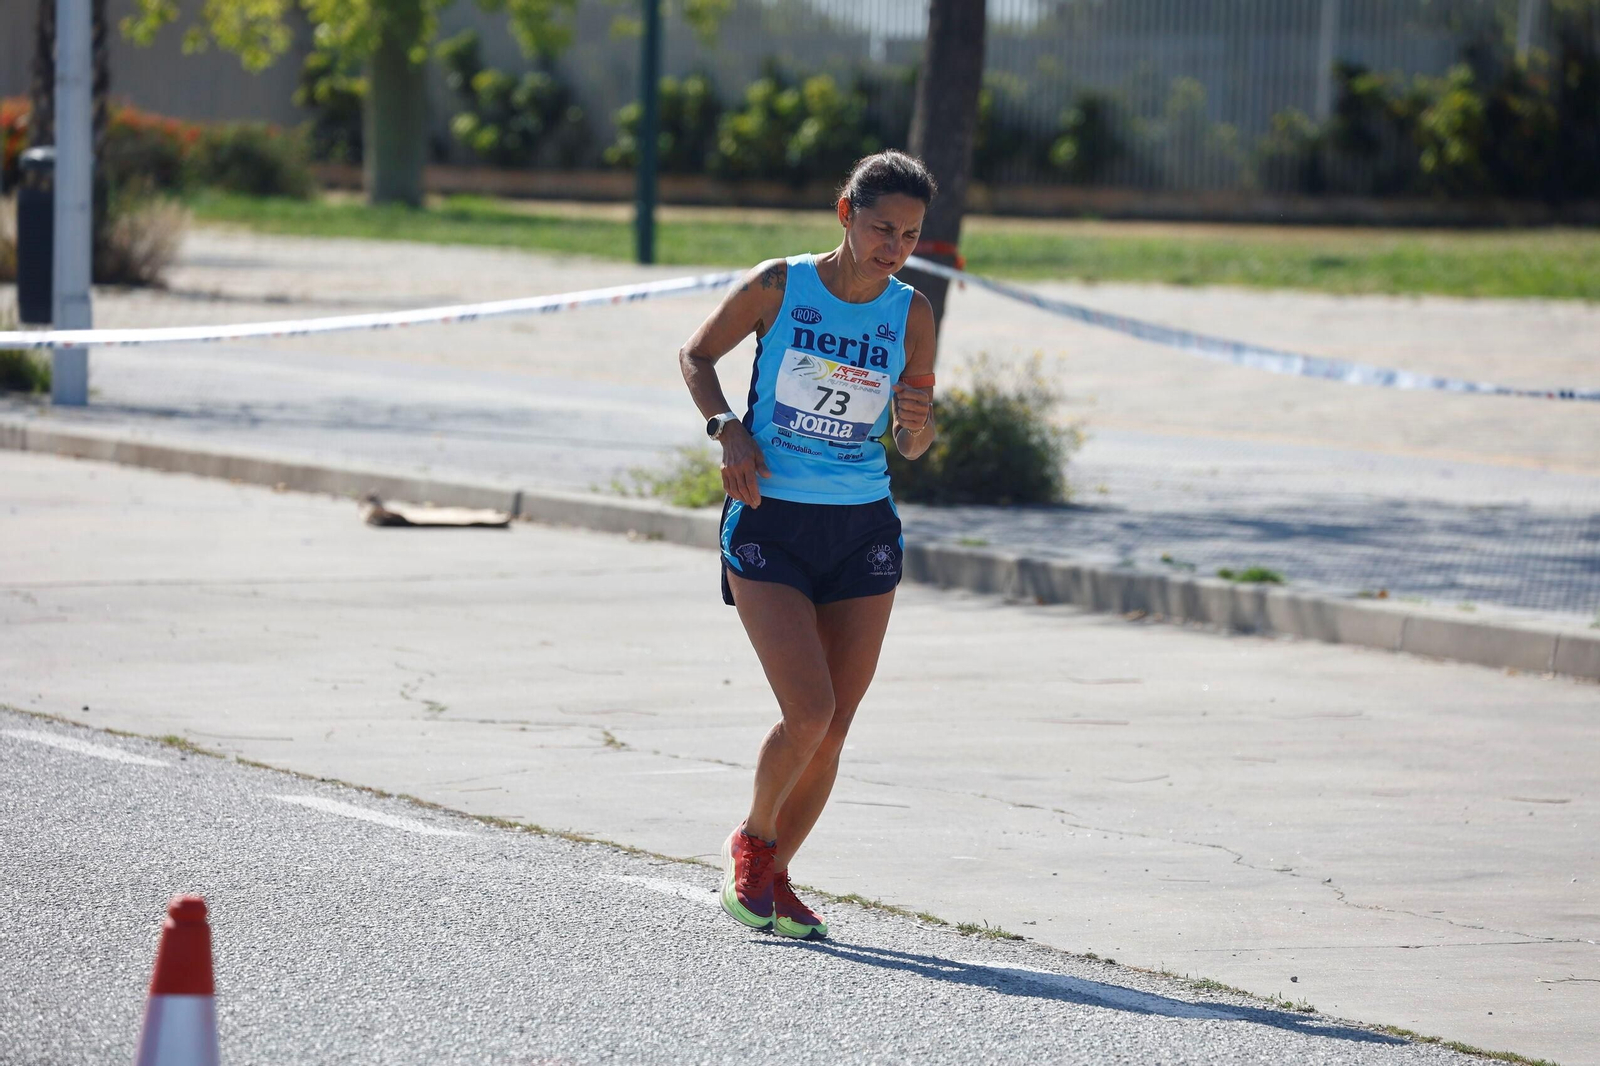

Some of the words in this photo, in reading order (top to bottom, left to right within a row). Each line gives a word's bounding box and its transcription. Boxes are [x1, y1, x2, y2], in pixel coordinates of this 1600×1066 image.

[792, 308, 822, 324] TROPS
[791, 326, 889, 369] nerja
[813, 385, 851, 416] 73
